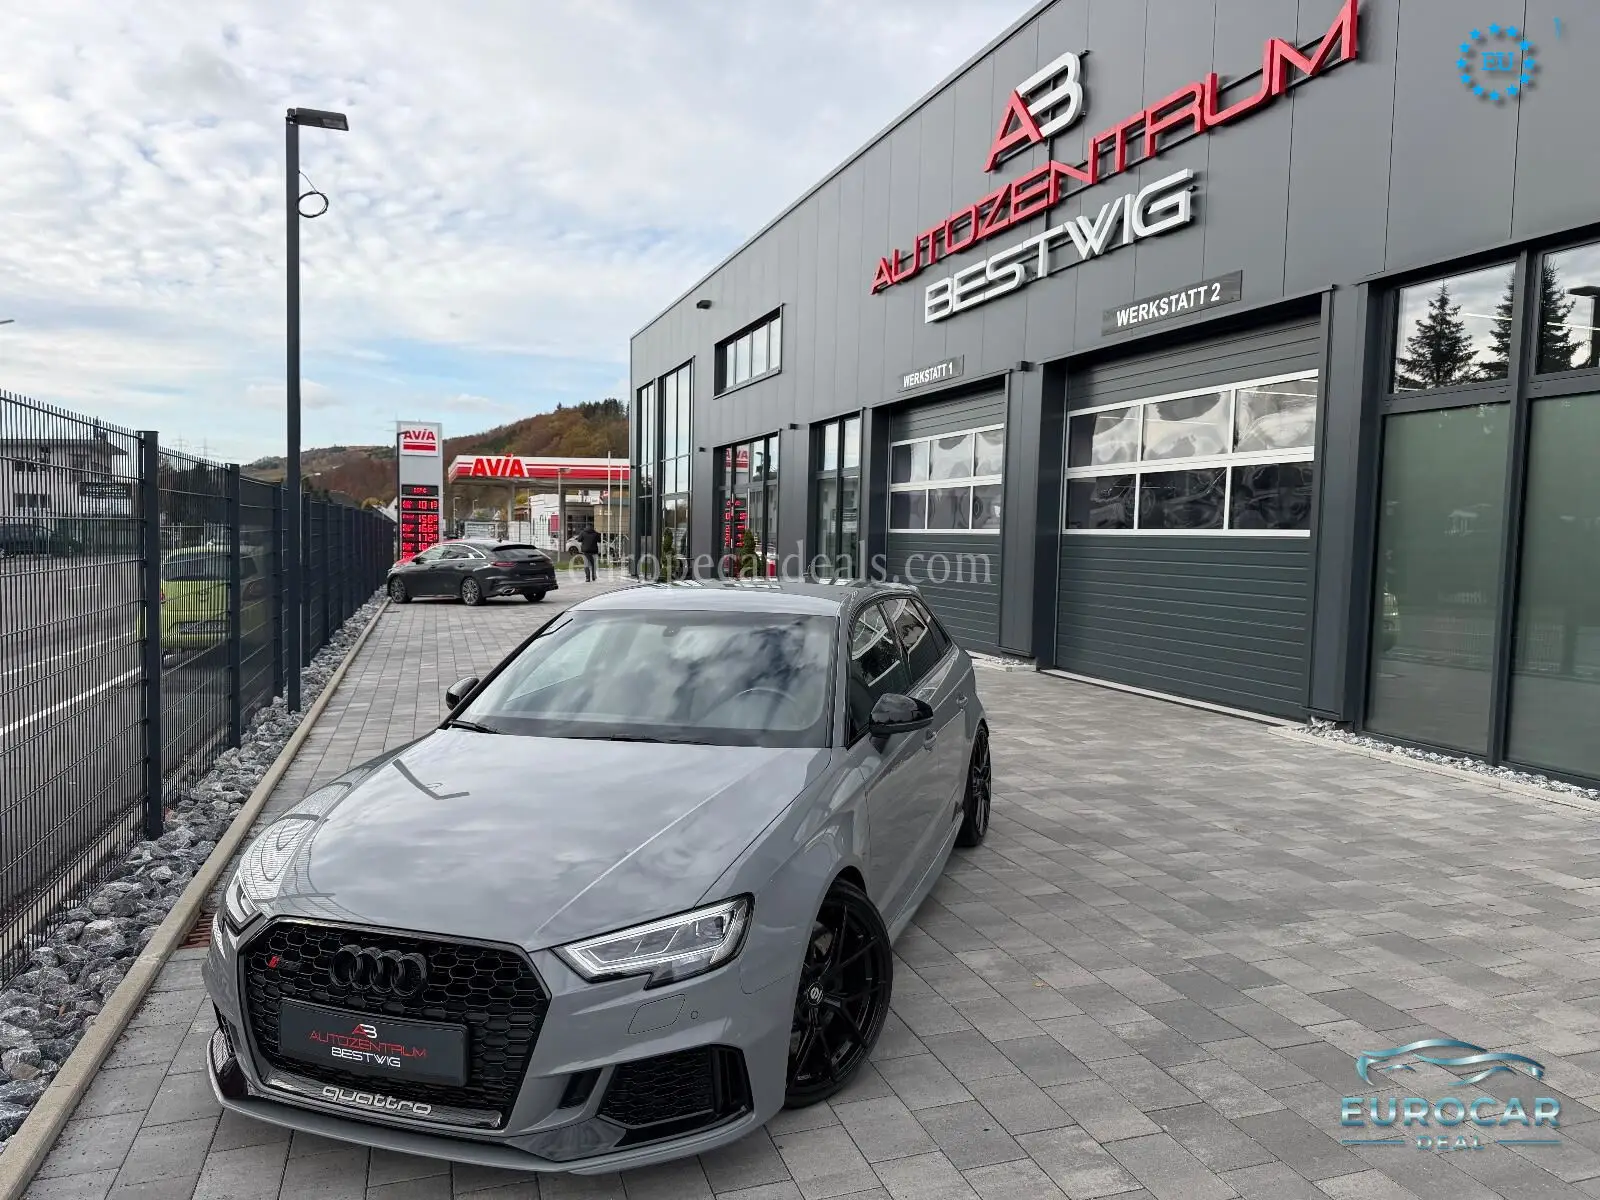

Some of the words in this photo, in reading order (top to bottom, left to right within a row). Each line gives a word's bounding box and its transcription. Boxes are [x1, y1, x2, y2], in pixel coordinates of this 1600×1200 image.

[871, 0, 1358, 295] AUTOZENTRUM
[924, 168, 1194, 325] BESTWIG
[1116, 285, 1208, 327] WERKSTATT
[1210, 282, 1221, 302] 2
[903, 363, 947, 388] WERKSTATT
[948, 361, 953, 375] 1
[310, 1030, 428, 1058] AUTOZENTRUM
[331, 1046, 401, 1068] BESTWIG
[322, 1085, 432, 1115] quattro
